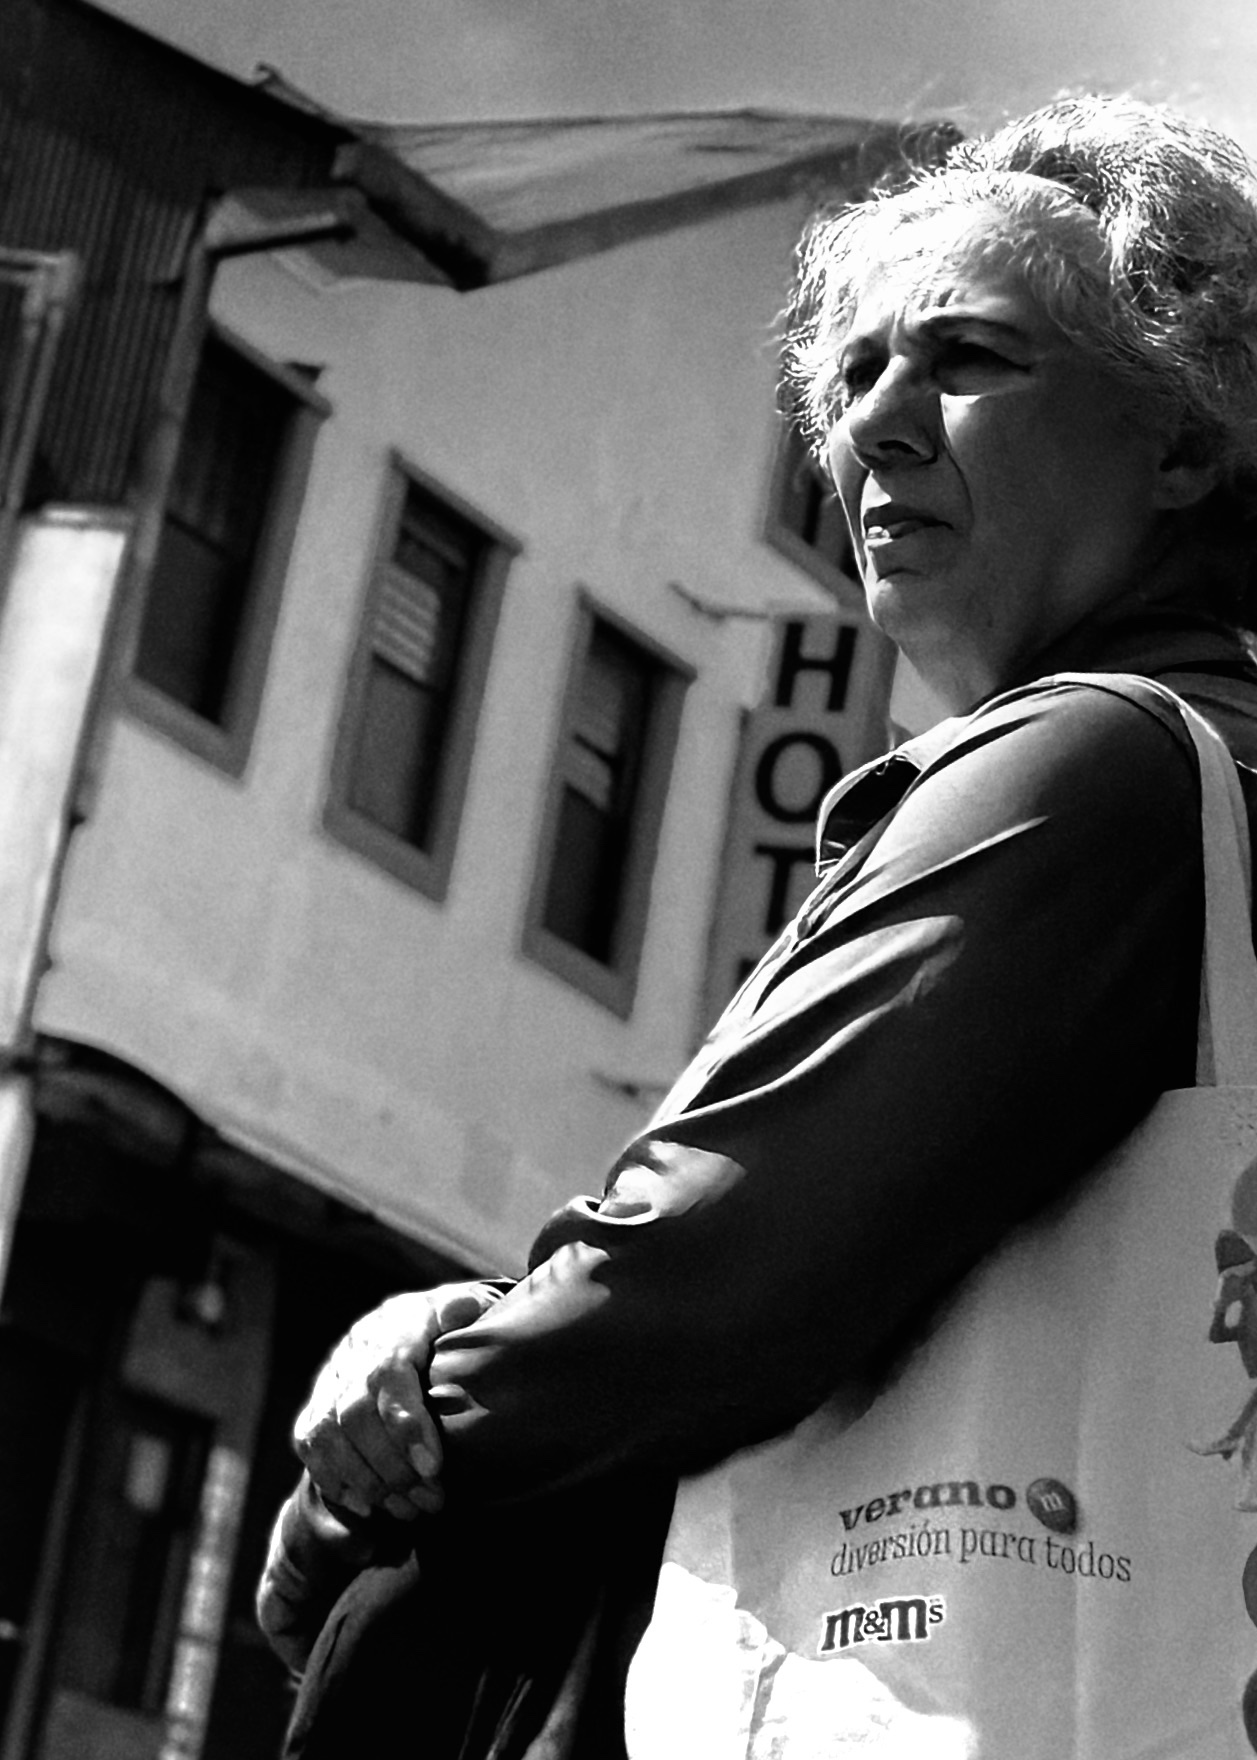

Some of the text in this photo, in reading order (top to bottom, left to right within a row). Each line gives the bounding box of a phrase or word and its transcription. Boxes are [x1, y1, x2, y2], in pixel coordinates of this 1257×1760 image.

[738, 620, 858, 986] HOT
[839, 1481, 1016, 1531] verano
[831, 1520, 1131, 1582] diversión para todos
